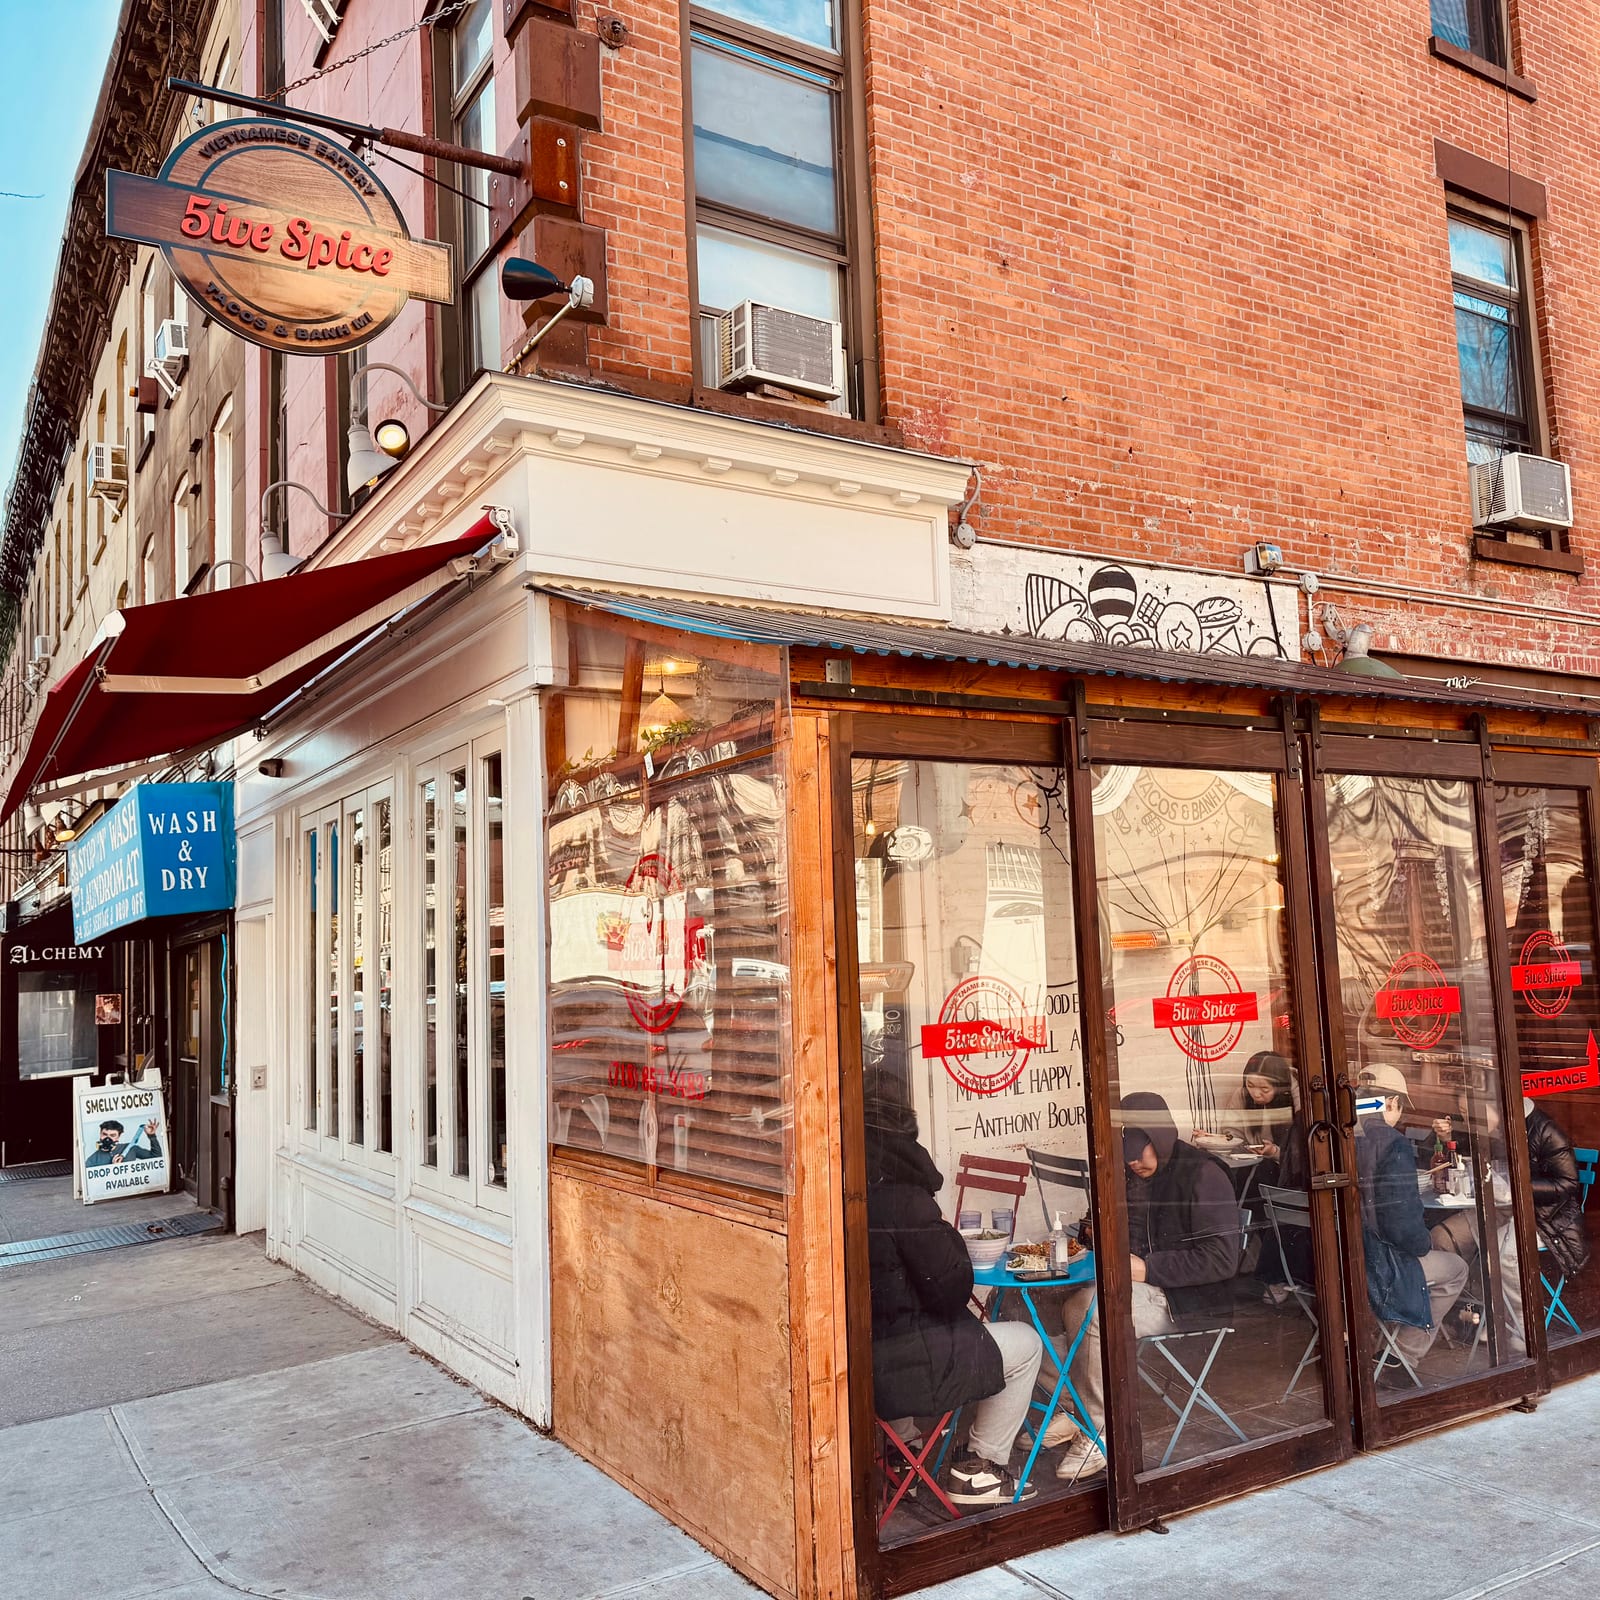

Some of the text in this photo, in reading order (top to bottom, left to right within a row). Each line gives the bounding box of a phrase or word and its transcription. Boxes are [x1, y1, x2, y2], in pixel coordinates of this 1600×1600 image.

[199, 127, 376, 195] VIETNAMESE EATERY
[181, 194, 394, 275] 5ive Spice
[206, 281, 373, 341] TACOS & BANH MI
[1136, 771, 1178, 820] TACOS
[1192, 790, 1220, 820] BANH
[148, 810, 217, 835] WASH
[78, 838, 96, 878] STOP
[108, 799, 138, 850] WASH
[178, 840, 193, 862] &
[80, 848, 140, 916] LAUNDROMAT
[161, 866, 208, 891] DRY
[132, 892, 144, 916] OFF
[9, 945, 106, 964] ALCHEMY
[1175, 960, 1231, 985] VIETNESE EATERY
[1524, 968, 1567, 985] 5ive Spice
[1202, 1000, 1237, 1022] Spice
[1392, 994, 1443, 1012] 5ive Spice
[945, 1029, 979, 1050] 5ive
[981, 1025, 1023, 1050] Spice
[1210, 1043, 1228, 1056] BANH
[1522, 1073, 1588, 1091] ENTRANCE
[86, 1092, 154, 1114] SMELLY SOCKS?
[1047, 1101, 1086, 1129] BOUR
[88, 1160, 165, 1180] DROP OFF SERVICE
[105, 1175, 150, 1190] AVAILABLE
